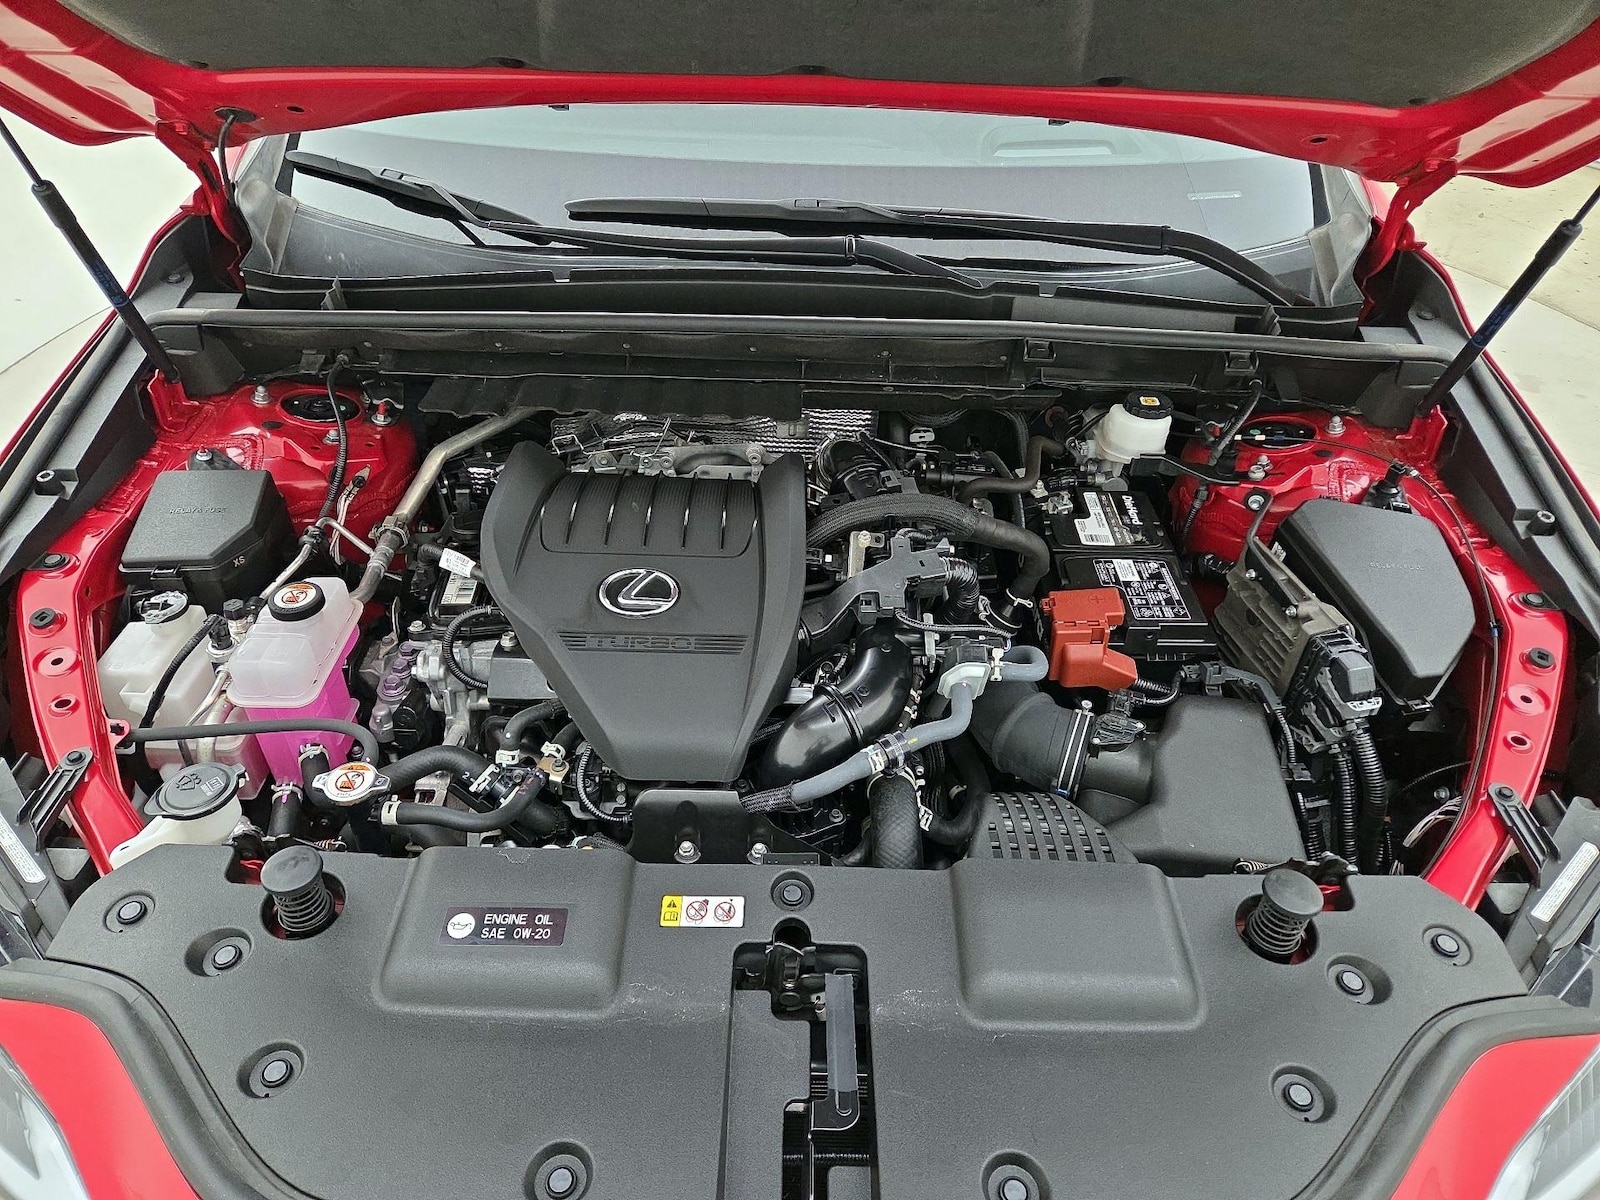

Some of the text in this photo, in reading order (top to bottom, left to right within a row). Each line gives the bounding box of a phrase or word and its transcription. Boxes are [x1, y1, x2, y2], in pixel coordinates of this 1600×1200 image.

[1122, 495, 1143, 525] DieHard
[233, 556, 245, 567] XS
[590, 635, 692, 649] TURBO
[483, 913, 553, 925] ENGINE OIL
[480, 927, 551, 939] SAE 0W-20
